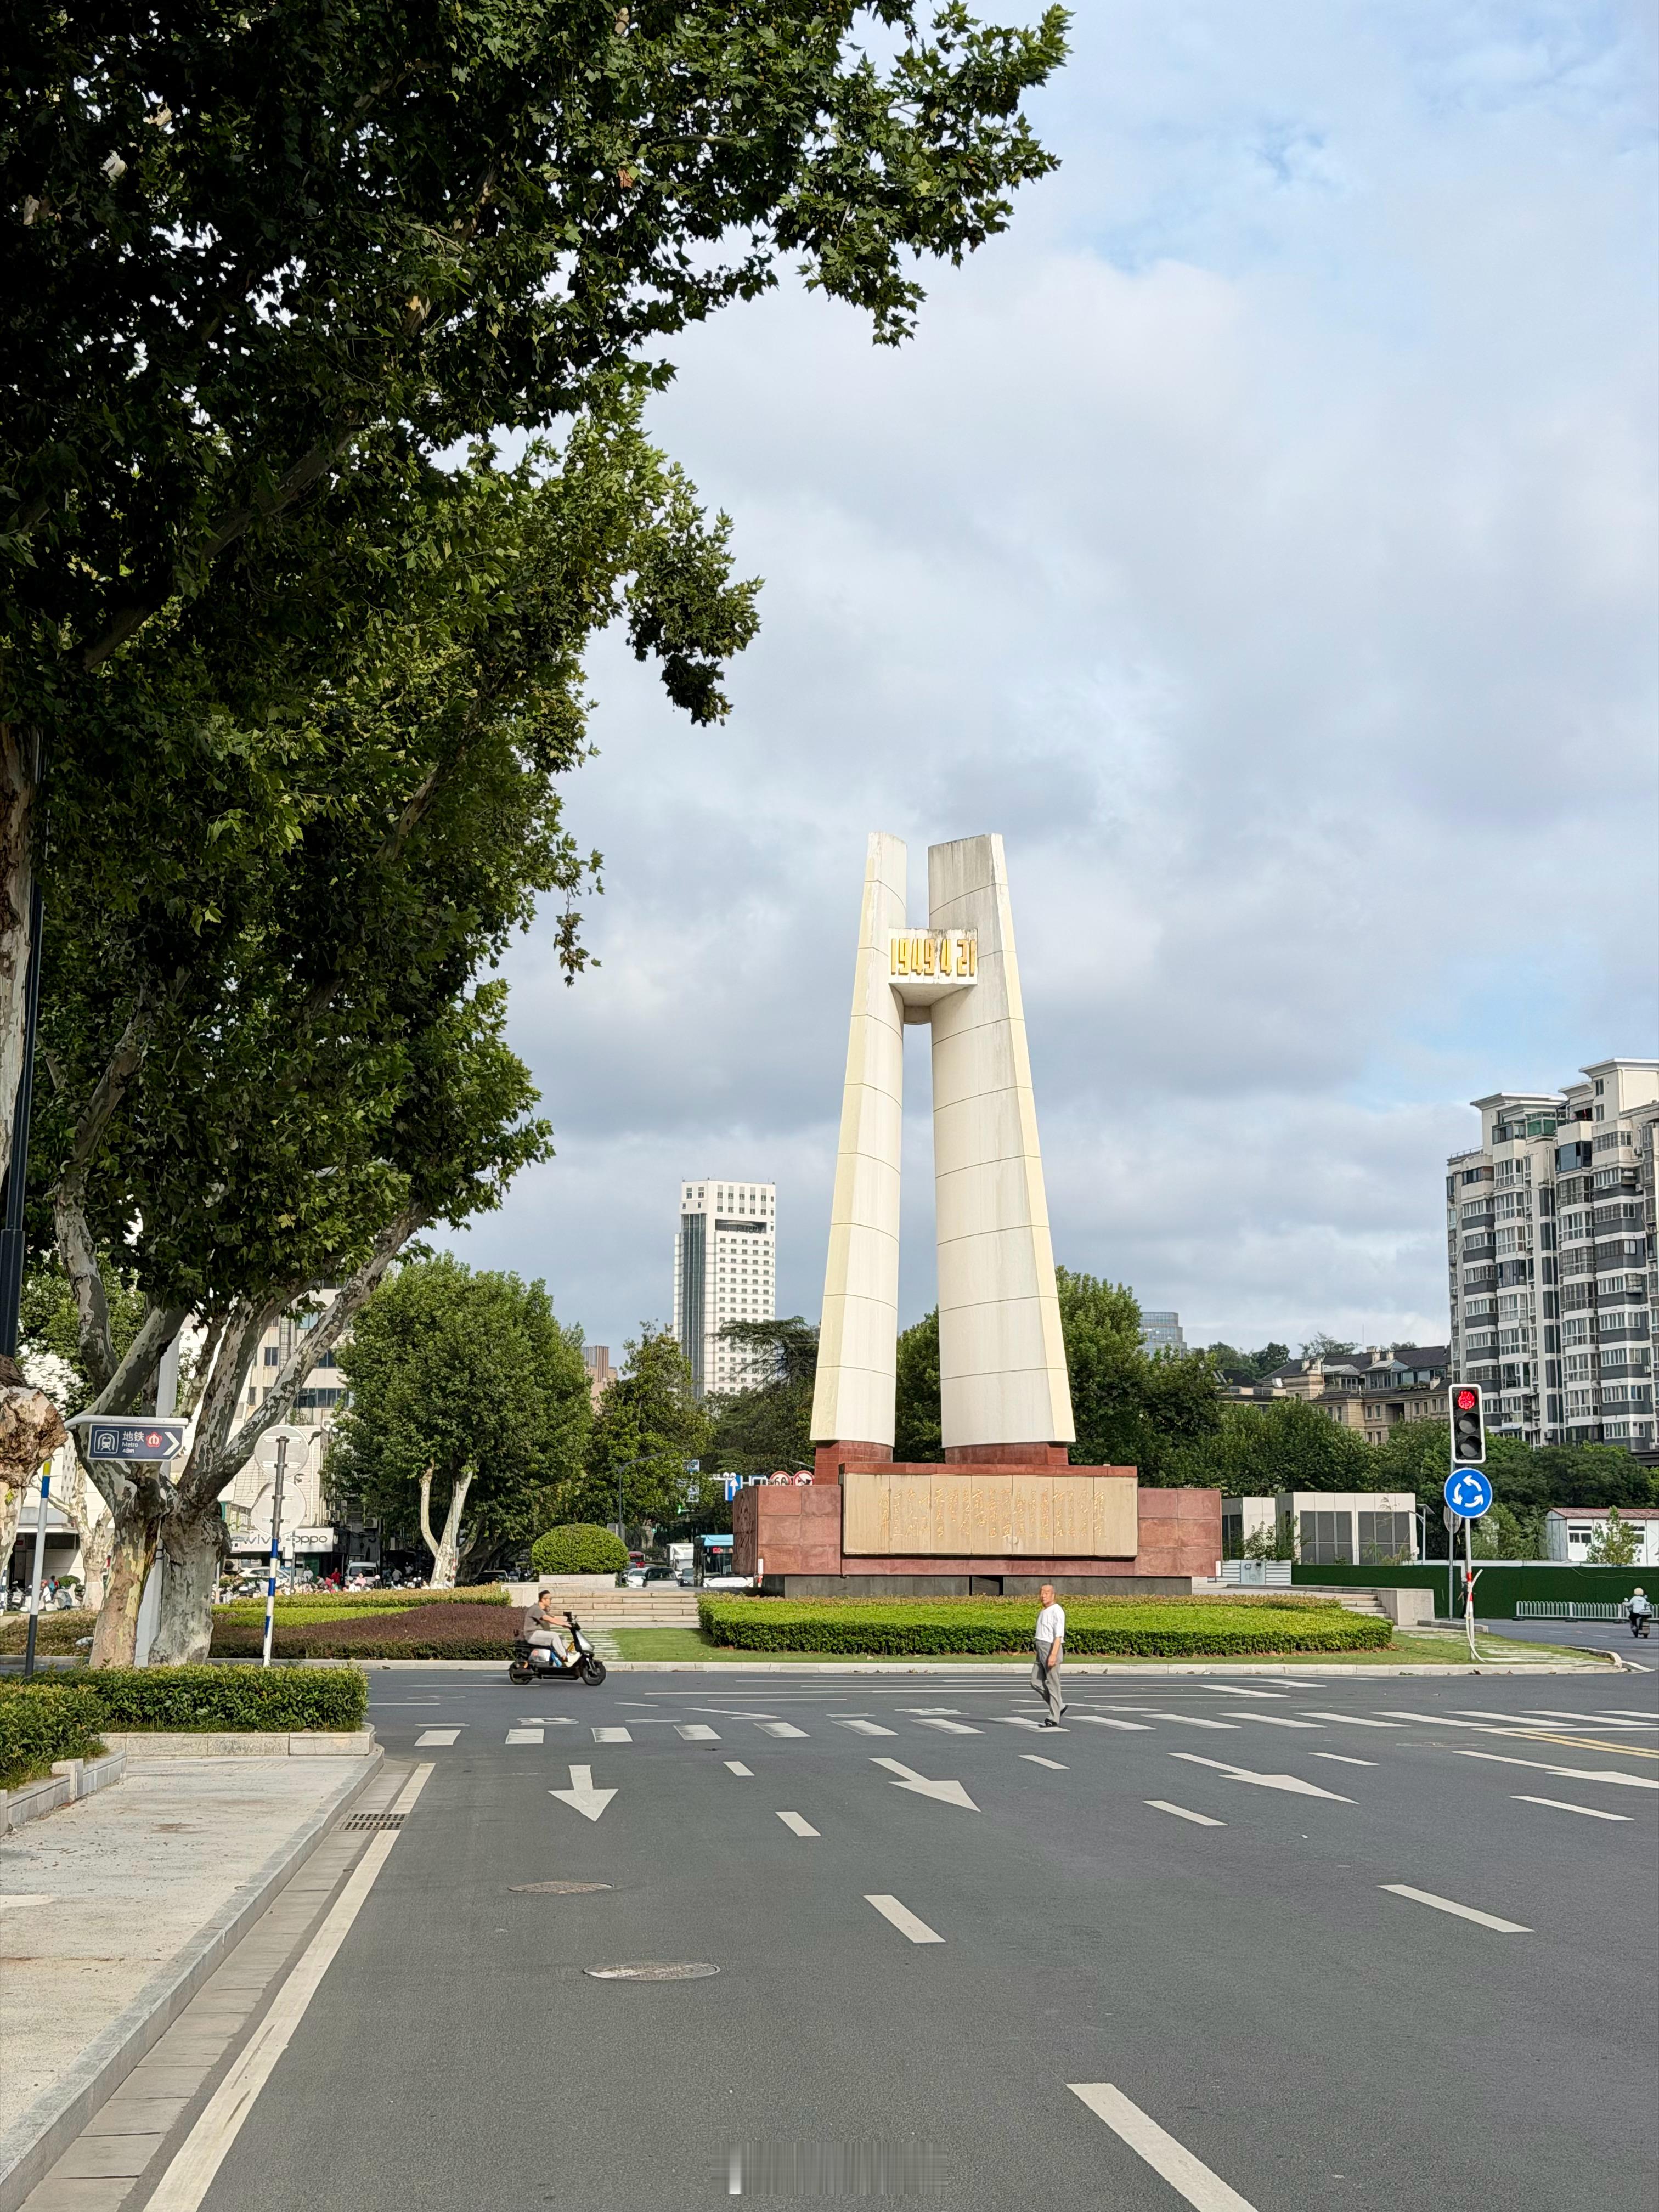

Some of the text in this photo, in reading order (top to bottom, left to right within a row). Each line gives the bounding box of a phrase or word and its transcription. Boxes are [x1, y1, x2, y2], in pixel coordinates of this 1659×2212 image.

[891, 938, 976, 977] 1949 4 21
[122, 1430, 145, 1442] 地铁
[247, 1534, 281, 1544] viv
